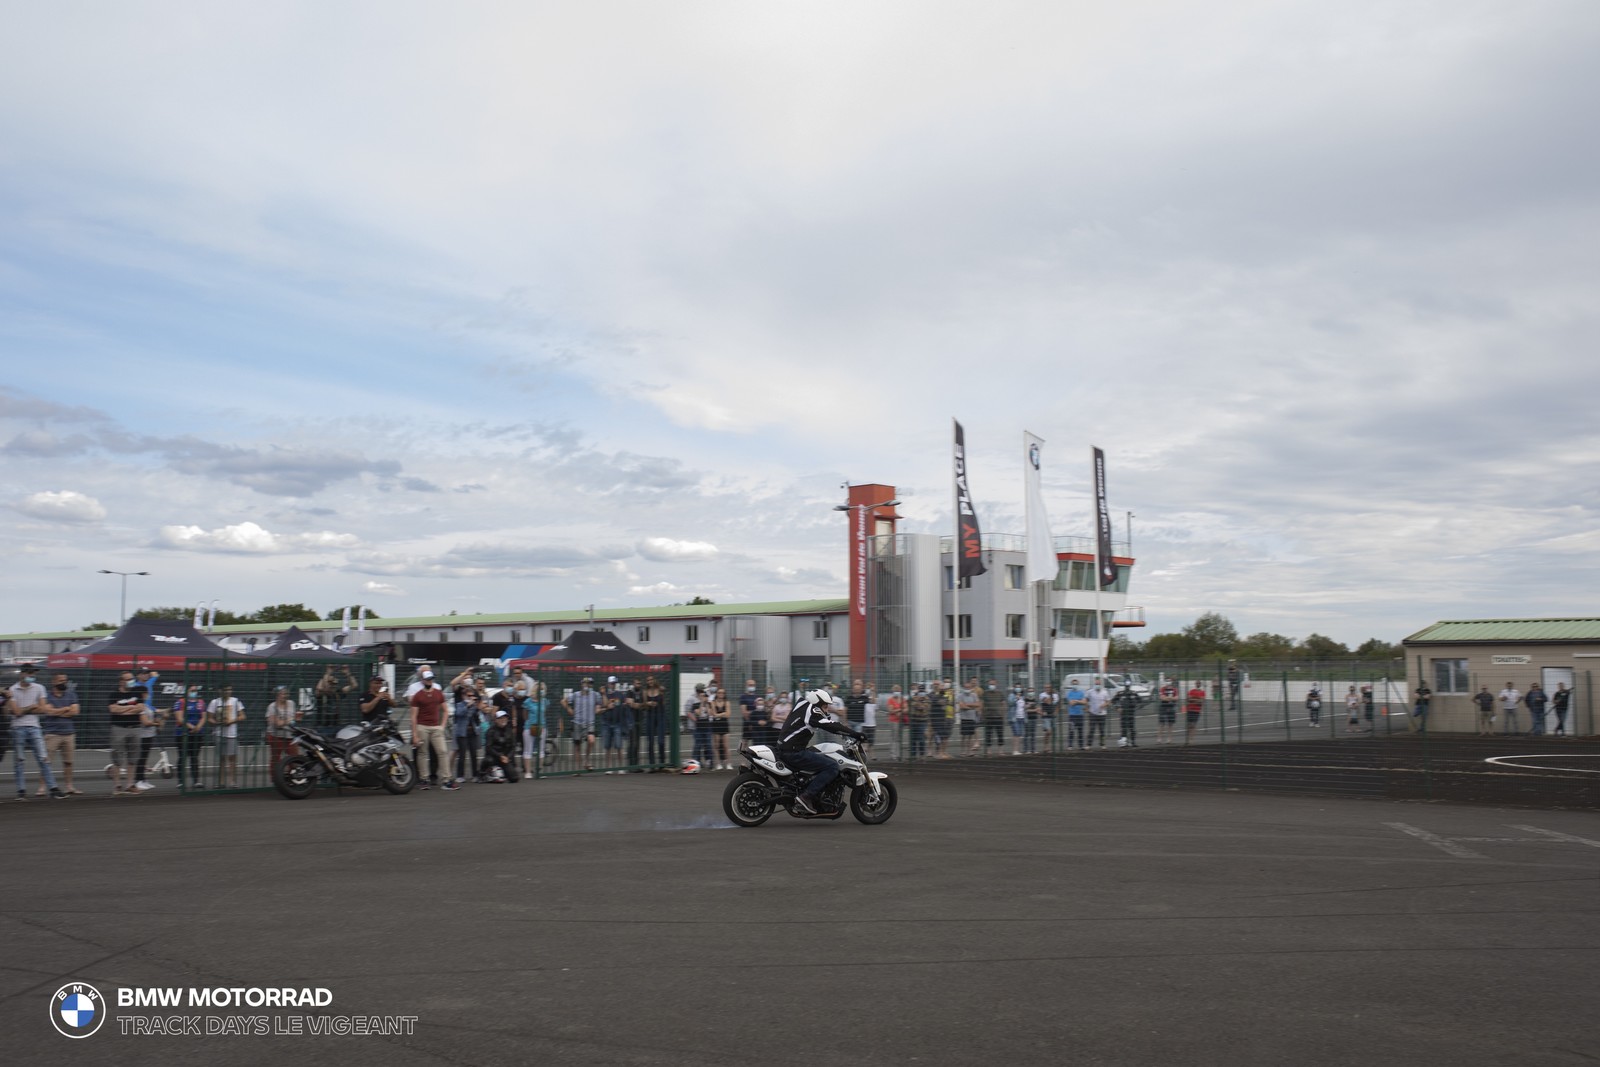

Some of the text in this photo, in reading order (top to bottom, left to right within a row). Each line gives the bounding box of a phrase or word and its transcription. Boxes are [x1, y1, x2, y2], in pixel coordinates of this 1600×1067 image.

[954, 443, 980, 558] MY PLACE
[857, 542, 866, 557] de
[857, 557, 866, 574] Val
